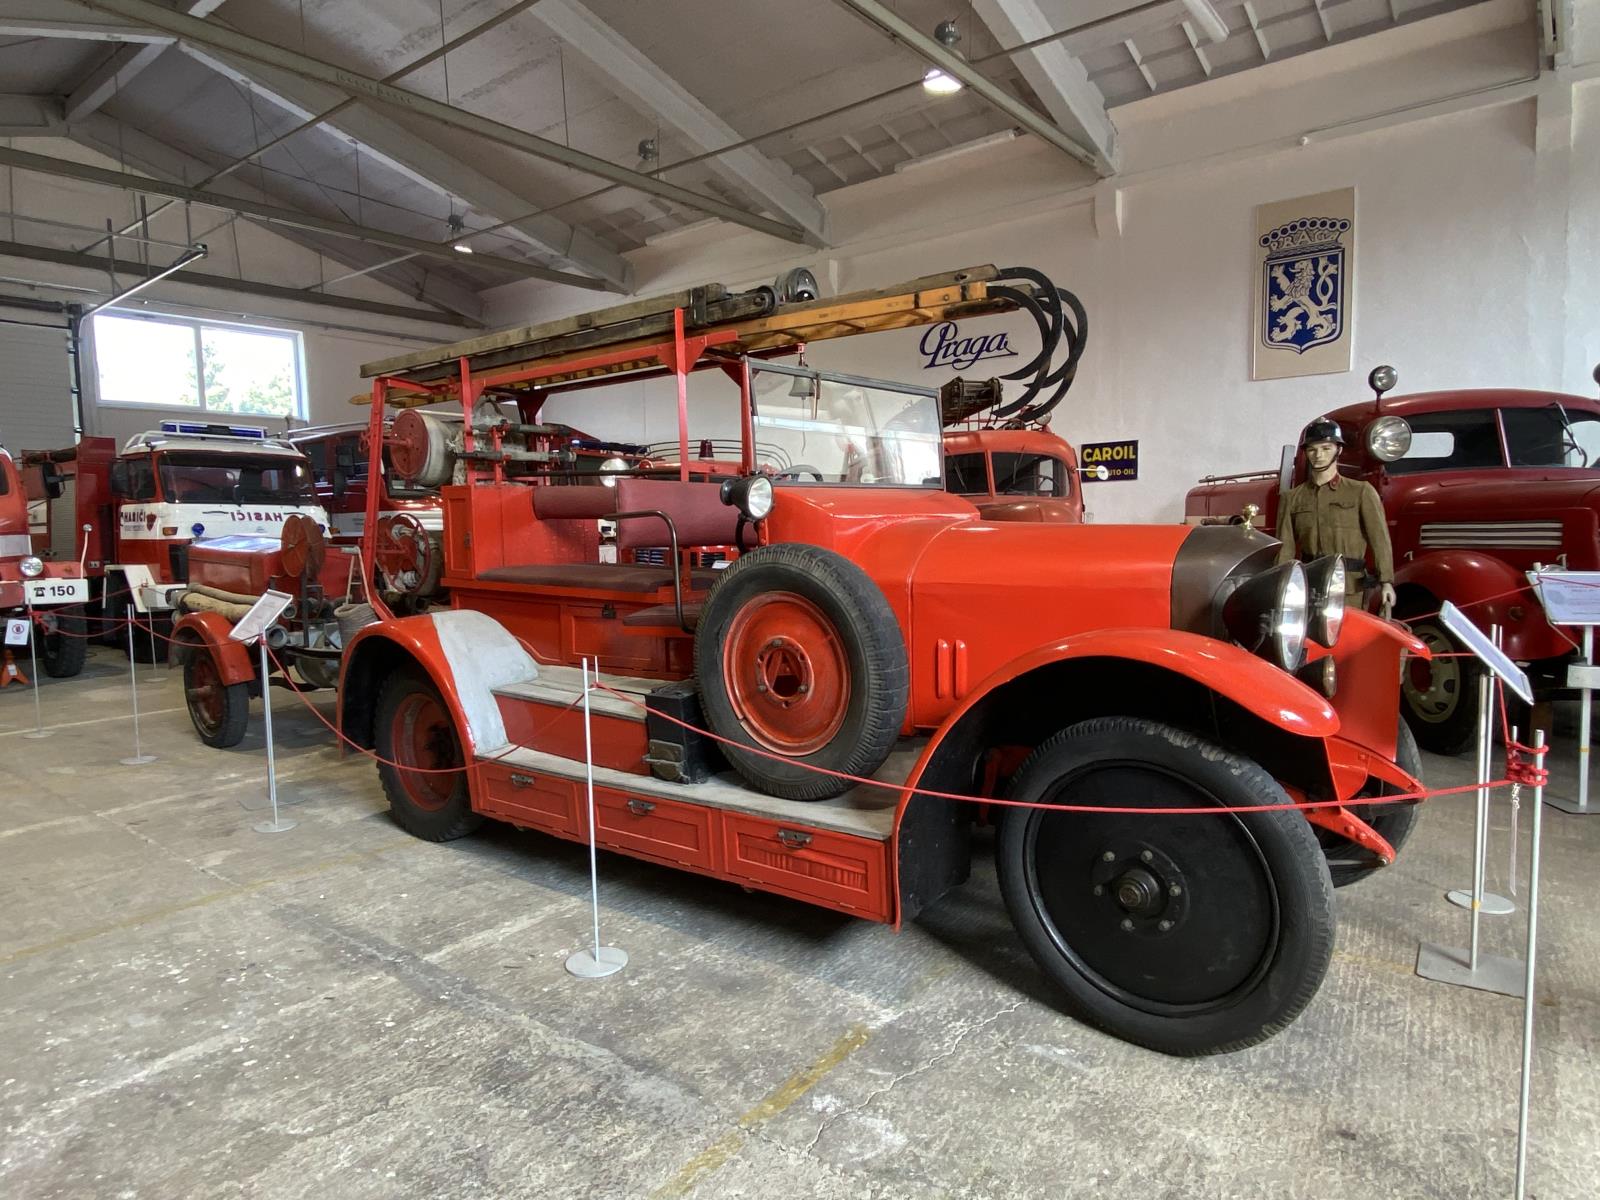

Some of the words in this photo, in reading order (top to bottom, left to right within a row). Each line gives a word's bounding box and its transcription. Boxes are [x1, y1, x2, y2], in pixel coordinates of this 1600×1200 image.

[919, 320, 1018, 370] Praga
[1082, 445, 1136, 462] CAROIL
[49, 585, 75, 597] 150
